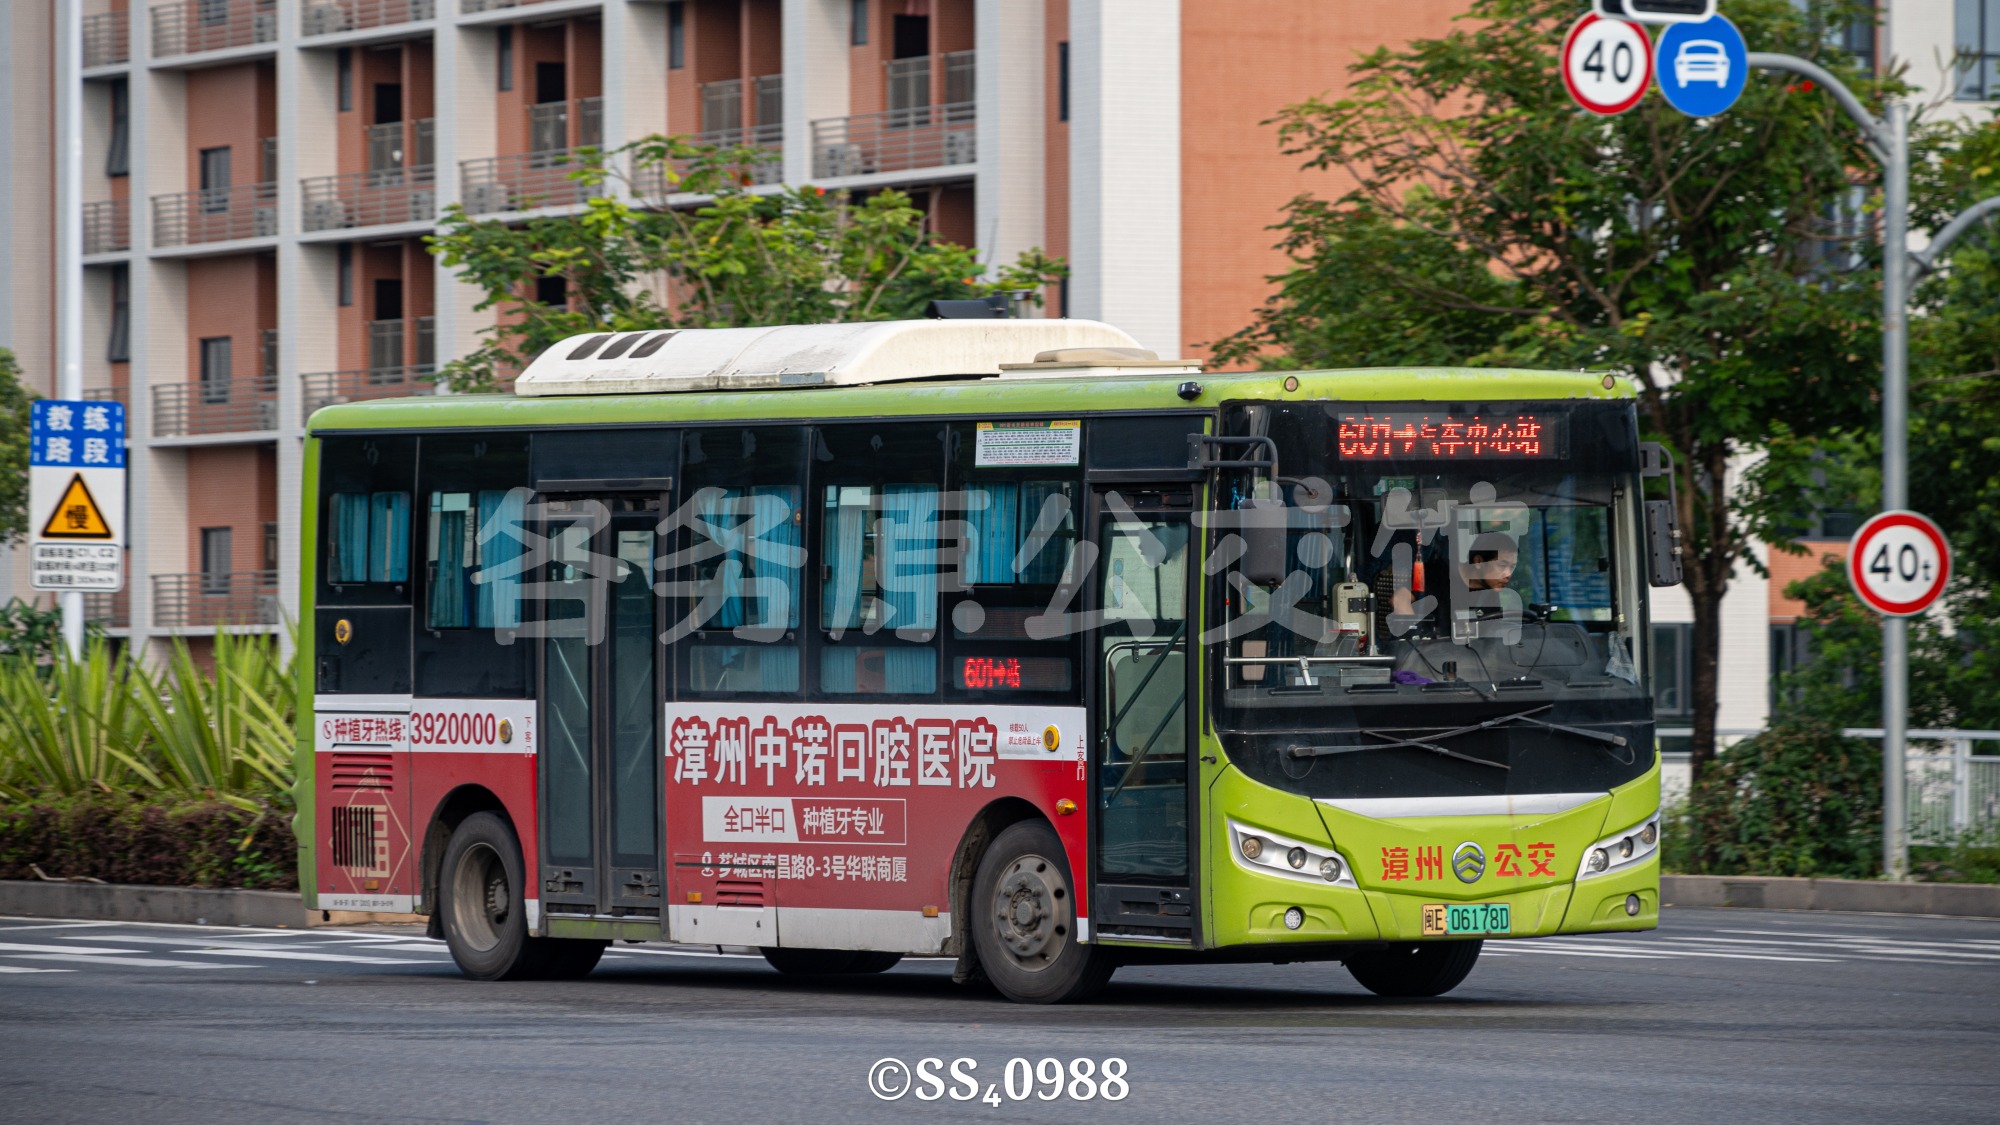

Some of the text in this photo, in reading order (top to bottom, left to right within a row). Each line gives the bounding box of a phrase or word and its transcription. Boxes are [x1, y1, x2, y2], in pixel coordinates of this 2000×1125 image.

[1581, 40, 1633, 83] 40
[46, 405, 110, 431] 教练
[45, 437, 109, 463] 路段
[1339, 416, 1391, 454] 601
[65, 505, 88, 529] 慢
[1870, 543, 1931, 582] 40t
[410, 713, 496, 745] 3920000
[672, 719, 998, 788] 漳州中诺口腔医院
[723, 805, 785, 834] 全口半口
[803, 807, 885, 836] 种植牙专业
[1381, 842, 1556, 882] 漳州 公交
